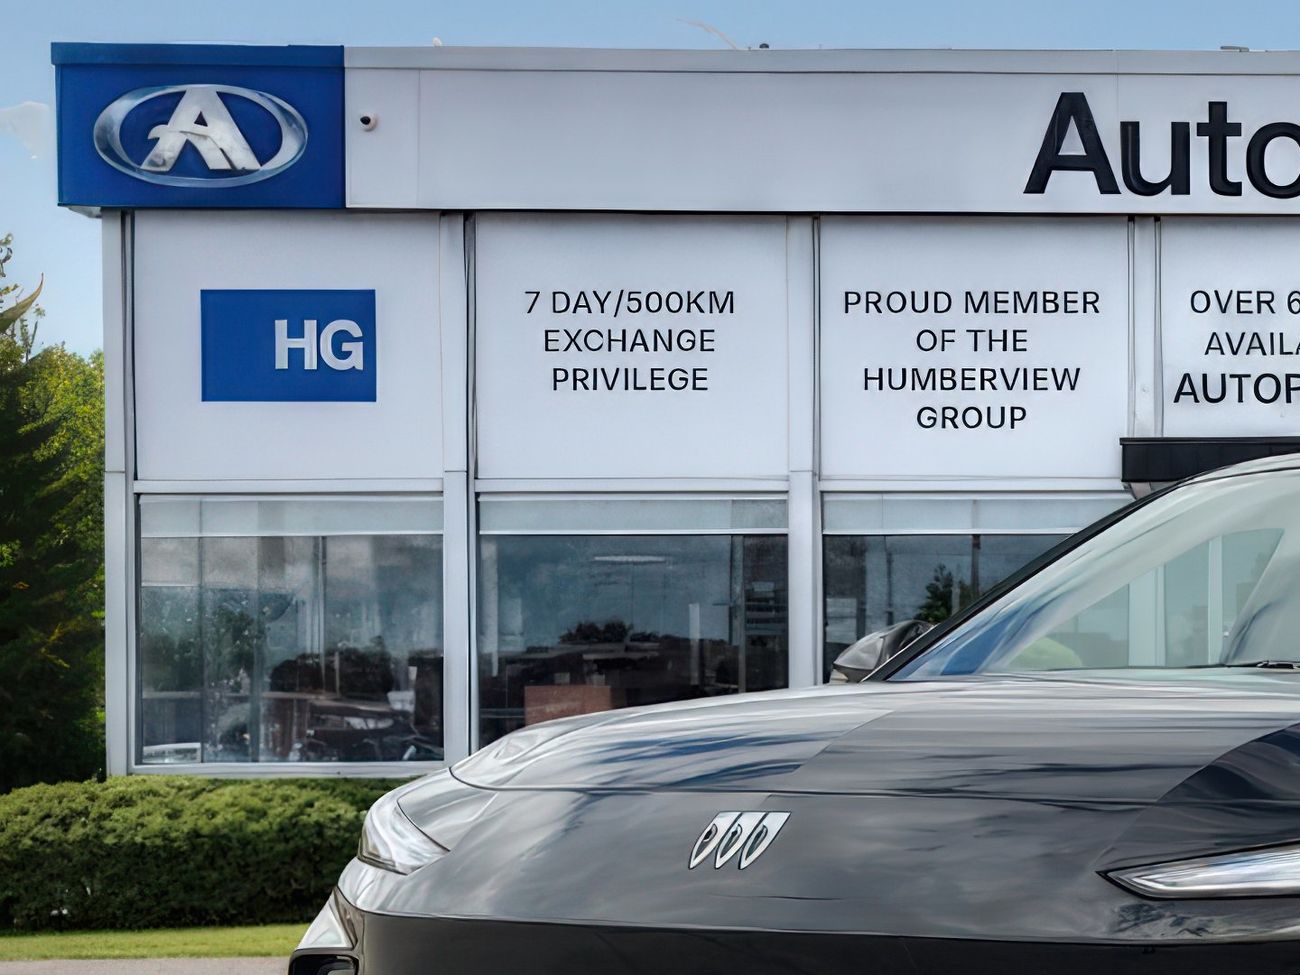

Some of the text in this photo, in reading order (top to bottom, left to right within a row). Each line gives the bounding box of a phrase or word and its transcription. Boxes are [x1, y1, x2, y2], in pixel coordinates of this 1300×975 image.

[525, 290, 734, 318] 7 DAY/500KM
[844, 290, 1100, 314] PROUD MEMBER
[1190, 289, 1276, 315] OVER
[274, 319, 364, 371] HG
[544, 328, 715, 353] EXCHANGE
[916, 329, 1028, 352] OF THE
[552, 367, 709, 391] PRIVILEGE
[864, 367, 1081, 391] HUMBERVIEW
[916, 406, 1027, 430] GROUP
